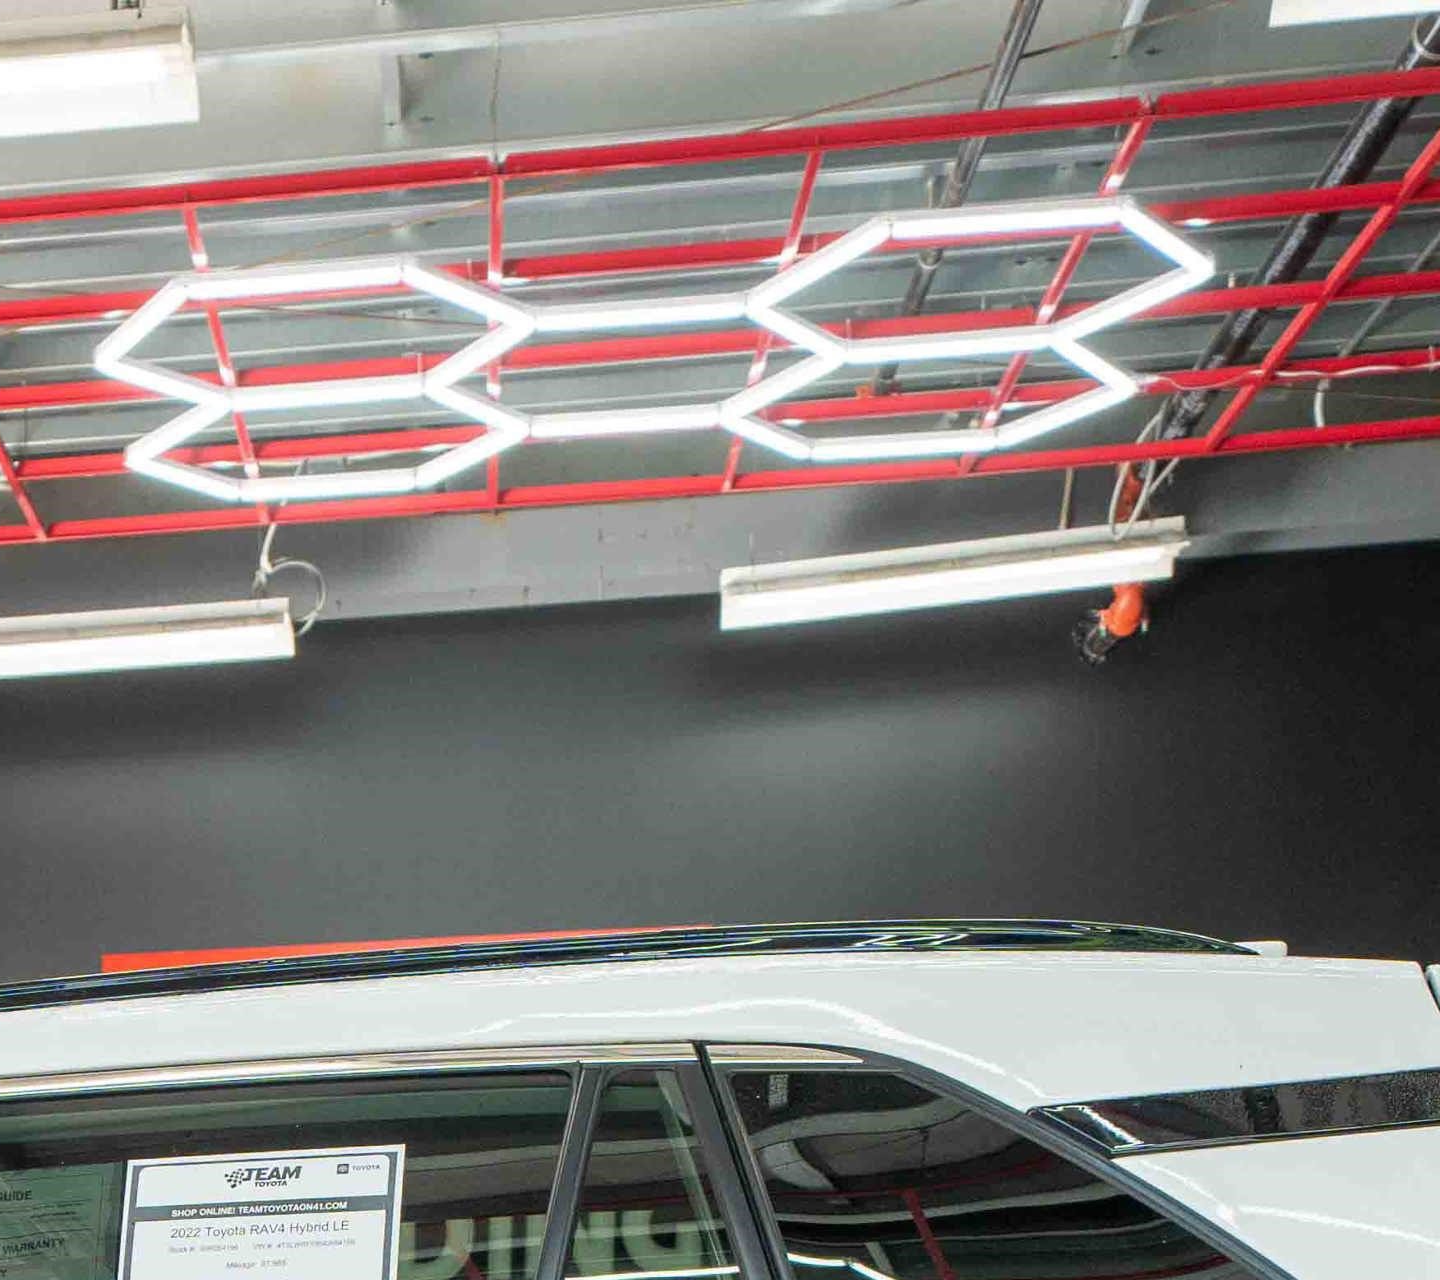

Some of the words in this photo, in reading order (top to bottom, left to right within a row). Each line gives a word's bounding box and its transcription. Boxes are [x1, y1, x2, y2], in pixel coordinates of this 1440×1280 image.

[243, 1166, 302, 1181] TEAM
[255, 1180, 288, 1188] TOYOTA
[172, 1208, 197, 1217] SHOP
[199, 1206, 236, 1216] ONLINE!
[239, 1201, 348, 1214] TEAMTOYOTAON41.COM
[170, 1228, 201, 1239] 2022
[206, 1226, 246, 1240] Toyota
[250, 1224, 285, 1235] RAV4
[290, 1221, 329, 1235] Hybrid
[333, 1220, 350, 1231] LE
[2, 1238, 66, 1256] WARRANTY
